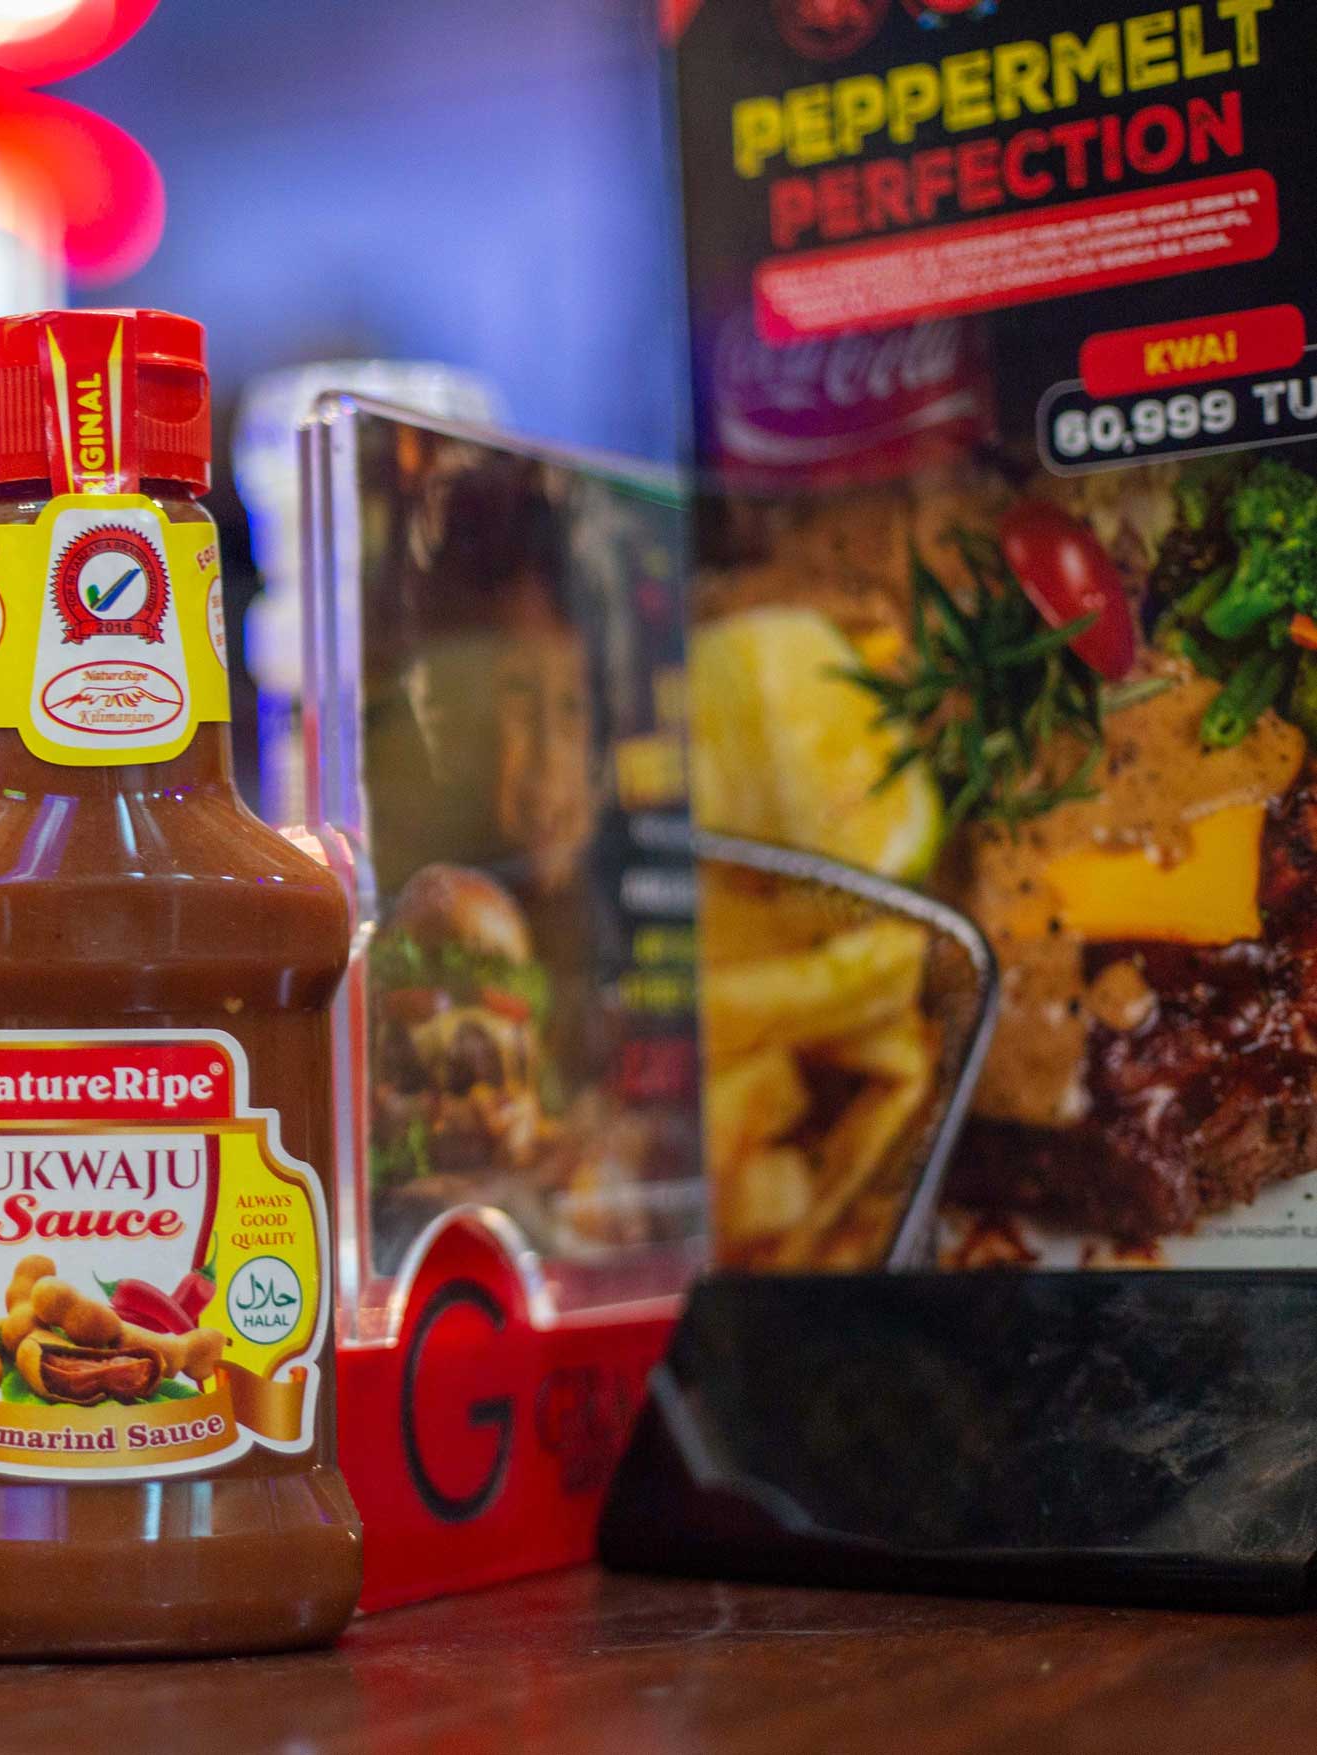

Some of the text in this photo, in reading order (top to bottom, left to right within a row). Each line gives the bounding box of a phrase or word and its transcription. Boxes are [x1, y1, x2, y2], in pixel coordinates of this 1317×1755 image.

[732, 0, 1275, 179] PEPPERMELT
[769, 91, 1244, 249] PERFECTION
[76, 372, 106, 495] RIGINAL
[97, 622, 133, 633] 2016
[236, 1194, 292, 1208] ALWAYS
[240, 1213, 288, 1227] GOOD
[231, 1231, 296, 1250] QUALITY
[236, 1271, 297, 1310] حلال
[243, 1315, 290, 1328] HALAL
[127, 1412, 224, 1449] Sauce
